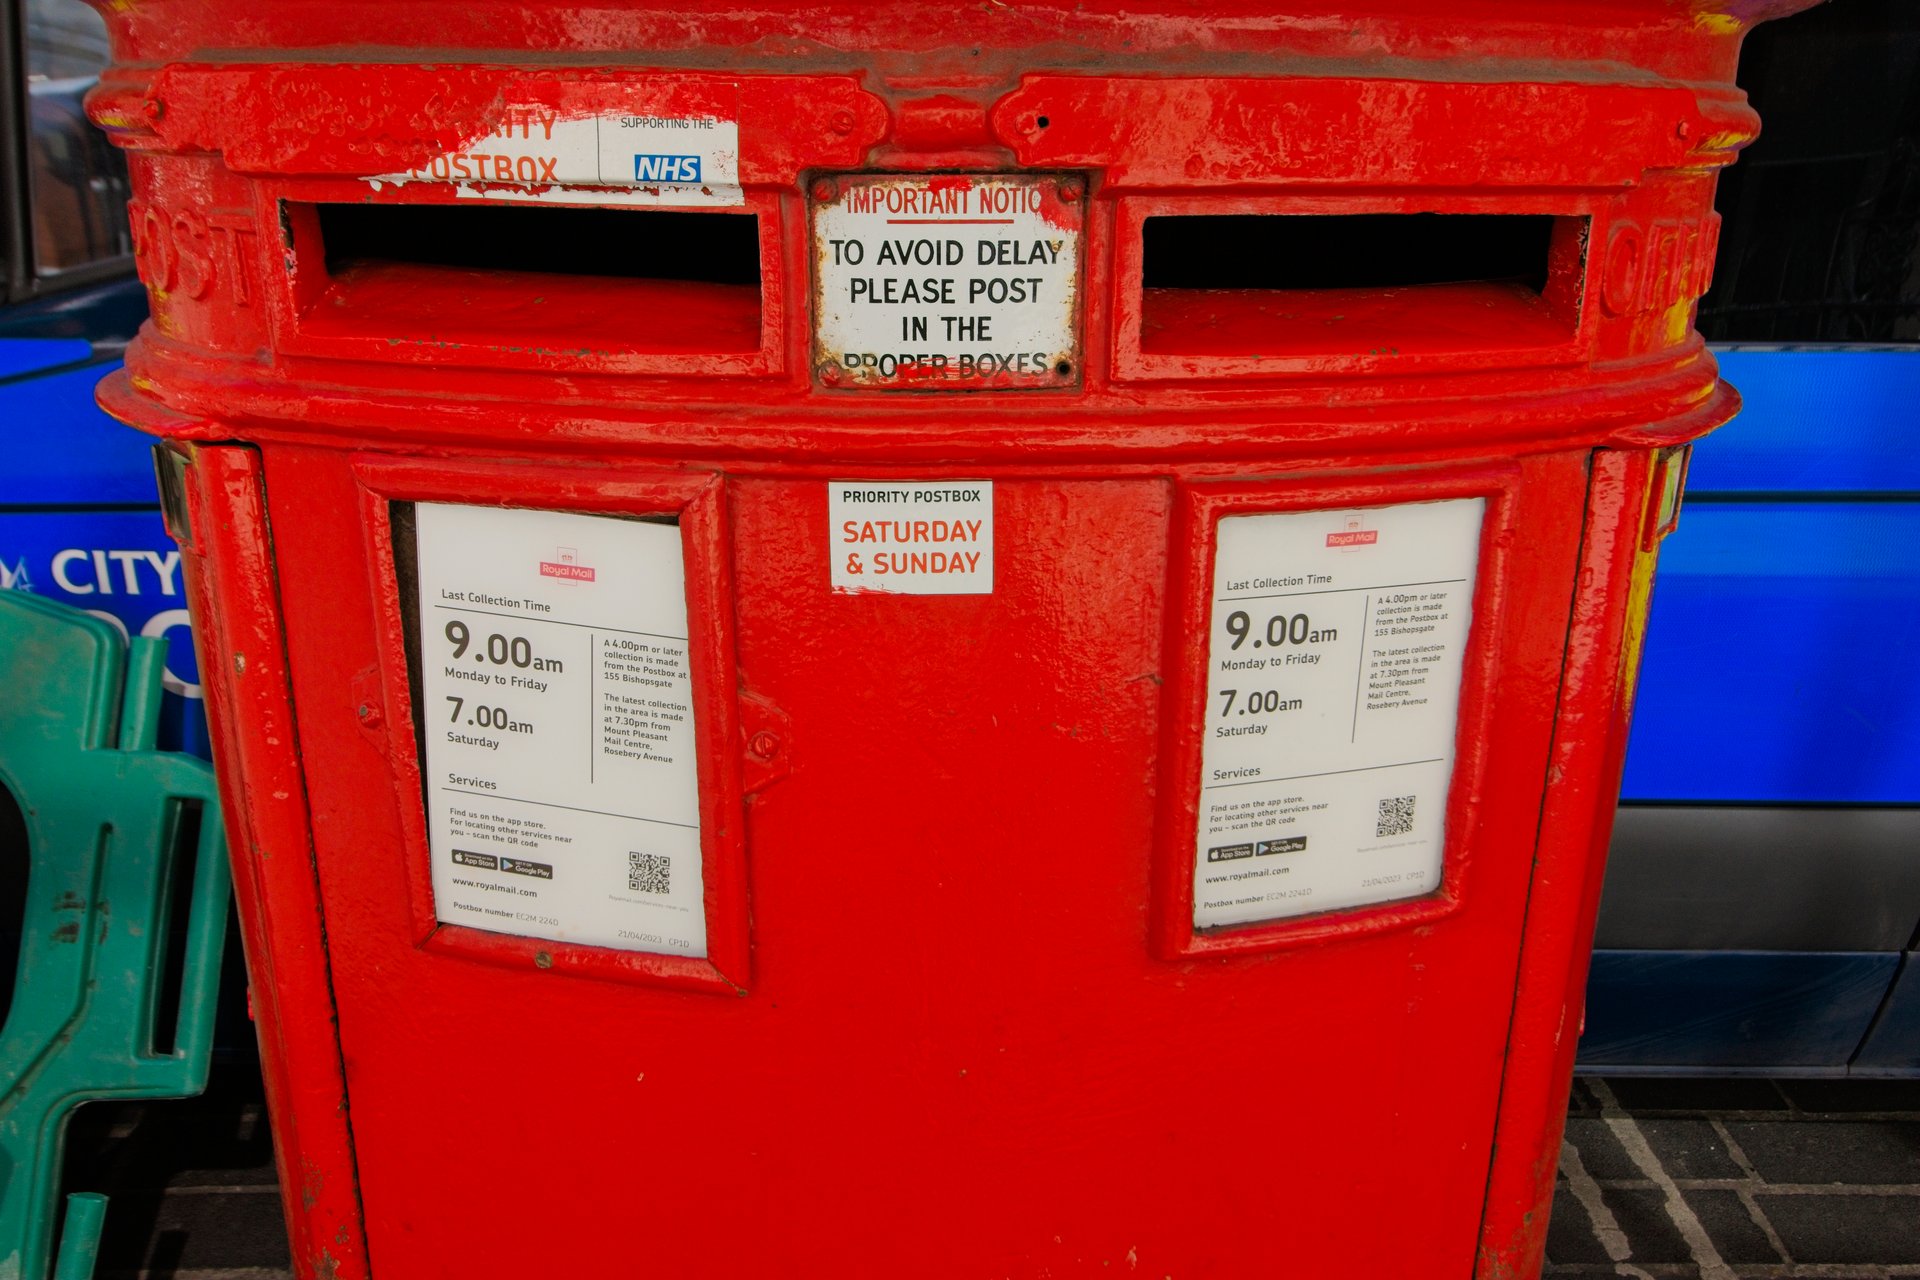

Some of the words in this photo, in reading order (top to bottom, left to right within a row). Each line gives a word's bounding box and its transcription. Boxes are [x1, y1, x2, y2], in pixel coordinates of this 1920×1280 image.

[495, 109, 557, 140] ITY
[620, 117, 690, 129] SUPPORTING
[692, 118, 714, 130] THE
[635, 156, 701, 181] NHS
[846, 187, 970, 214] IMPORTANT
[980, 187, 1042, 214] NOTIC
[829, 239, 864, 265] TO
[876, 239, 964, 265] AVOID
[977, 239, 1064, 265] DELAY
[850, 278, 955, 304] PLEASE
[969, 278, 1043, 304] POST
[902, 316, 928, 341] IN
[941, 316, 993, 341] THE
[959, 353, 1048, 379] BOXES
[843, 491, 910, 503] PRIORITY
[914, 490, 981, 502] POSTBOX
[843, 520, 982, 543] SATURDAY
[1328, 533, 1354, 545] Royal
[1355, 532, 1376, 543] Mail
[51, 549, 181, 595] CITY
[542, 563, 570, 577] Royal
[571, 567, 593, 579] Mail
[846, 552, 863, 575] &
[873, 552, 981, 574] SUNDAY
[1227, 580, 1249, 590] Last
[1253, 576, 1303, 589] Collection
[1306, 574, 1332, 584] Time
[441, 588, 465, 601] Last
[468, 592, 520, 608] Collection
[523, 599, 550, 612] Time
[1385, 594, 1417, 604] 4.00pm
[1376, 606, 1412, 615] collection
[1410, 614, 1438, 622] Postbox
[1226, 610, 1337, 651] 9.00am
[1374, 628, 1388, 636] 155
[1390, 625, 1435, 635] Bishopsgate
[445, 620, 563, 673] 9.00am
[612, 639, 648, 652] 4.00pm
[663, 647, 682, 656] later
[1372, 649, 1386, 657] The
[1388, 648, 1409, 656] latest
[1411, 645, 1445, 654] collection
[604, 651, 643, 662] collection
[646, 655, 653, 663] is
[655, 658, 678, 667] made
[1221, 658, 1266, 671] Monday
[1270, 657, 1281, 666] to
[1285, 653, 1320, 665] Friday
[1380, 659, 1392, 667] the
[1421, 654, 1441, 662] made
[604, 660, 624, 670] from
[626, 664, 640, 672] the
[643, 666, 675, 677] Postbox
[1380, 668, 1409, 678] 7.30pm
[445, 666, 490, 685] Monday
[494, 674, 506, 685] to
[511, 675, 547, 693] Friday
[604, 671, 619, 681] 155
[622, 674, 672, 688] Bishopsgate
[1368, 681, 1392, 689] Mount
[1394, 677, 1425, 686] Pleasant
[604, 692, 619, 702] The
[622, 695, 645, 706] latest
[647, 700, 686, 711] collection
[1219, 689, 1302, 717] 7.00am
[1367, 691, 1383, 699] Mail
[604, 703, 612, 711] in
[614, 705, 628, 714] the
[630, 708, 648, 716] area
[651, 710, 658, 718] is
[660, 713, 683, 721] made
[1366, 701, 1400, 710] Rosebery
[1401, 698, 1428, 706] Avenue
[446, 695, 533, 734] 7.00am
[615, 715, 648, 728] 7.30pm
[651, 721, 670, 731] from
[604, 725, 630, 736] Mount
[632, 729, 667, 741] Pleasant
[1216, 723, 1268, 738] Saturday
[447, 731, 499, 750] Saturday
[604, 736, 621, 745] Mail
[604, 746, 641, 760] Rosebery
[643, 752, 672, 763] Avenue
[448, 773, 496, 790] Services
[1213, 767, 1260, 780] Services
[1210, 804, 1227, 812] Find
[1252, 800, 1265, 808] the
[1283, 796, 1305, 805] store.
[449, 807, 466, 816] Find
[492, 815, 504, 823] the
[507, 818, 521, 826] app
[523, 820, 545, 829] store.
[1224, 812, 1255, 821] locating
[1257, 809, 1277, 817] other
[1279, 805, 1309, 814] services
[450, 817, 462, 825] For
[464, 820, 495, 832] locating
[497, 826, 518, 834] other
[520, 830, 552, 840] services
[1209, 826, 1222, 834] you
[1250, 820, 1263, 828] the
[1265, 818, 1276, 826] QR
[1278, 816, 1295, 824] code
[472, 832, 490, 840] scan
[492, 834, 504, 842] the
[507, 836, 518, 844] QR
[520, 840, 538, 848] code
[464, 857, 478, 865] App
[478, 859, 495, 868] Store
[515, 864, 537, 875] Google
[1205, 867, 1289, 884] www.royalmail.com
[452, 878, 537, 897] www.royalmail.com
[453, 901, 482, 912] Postbox
[484, 908, 513, 918] number
[1203, 900, 1233, 908] Postbox
[1235, 896, 1264, 904] number
[618, 929, 662, 943] 21/04/2023
